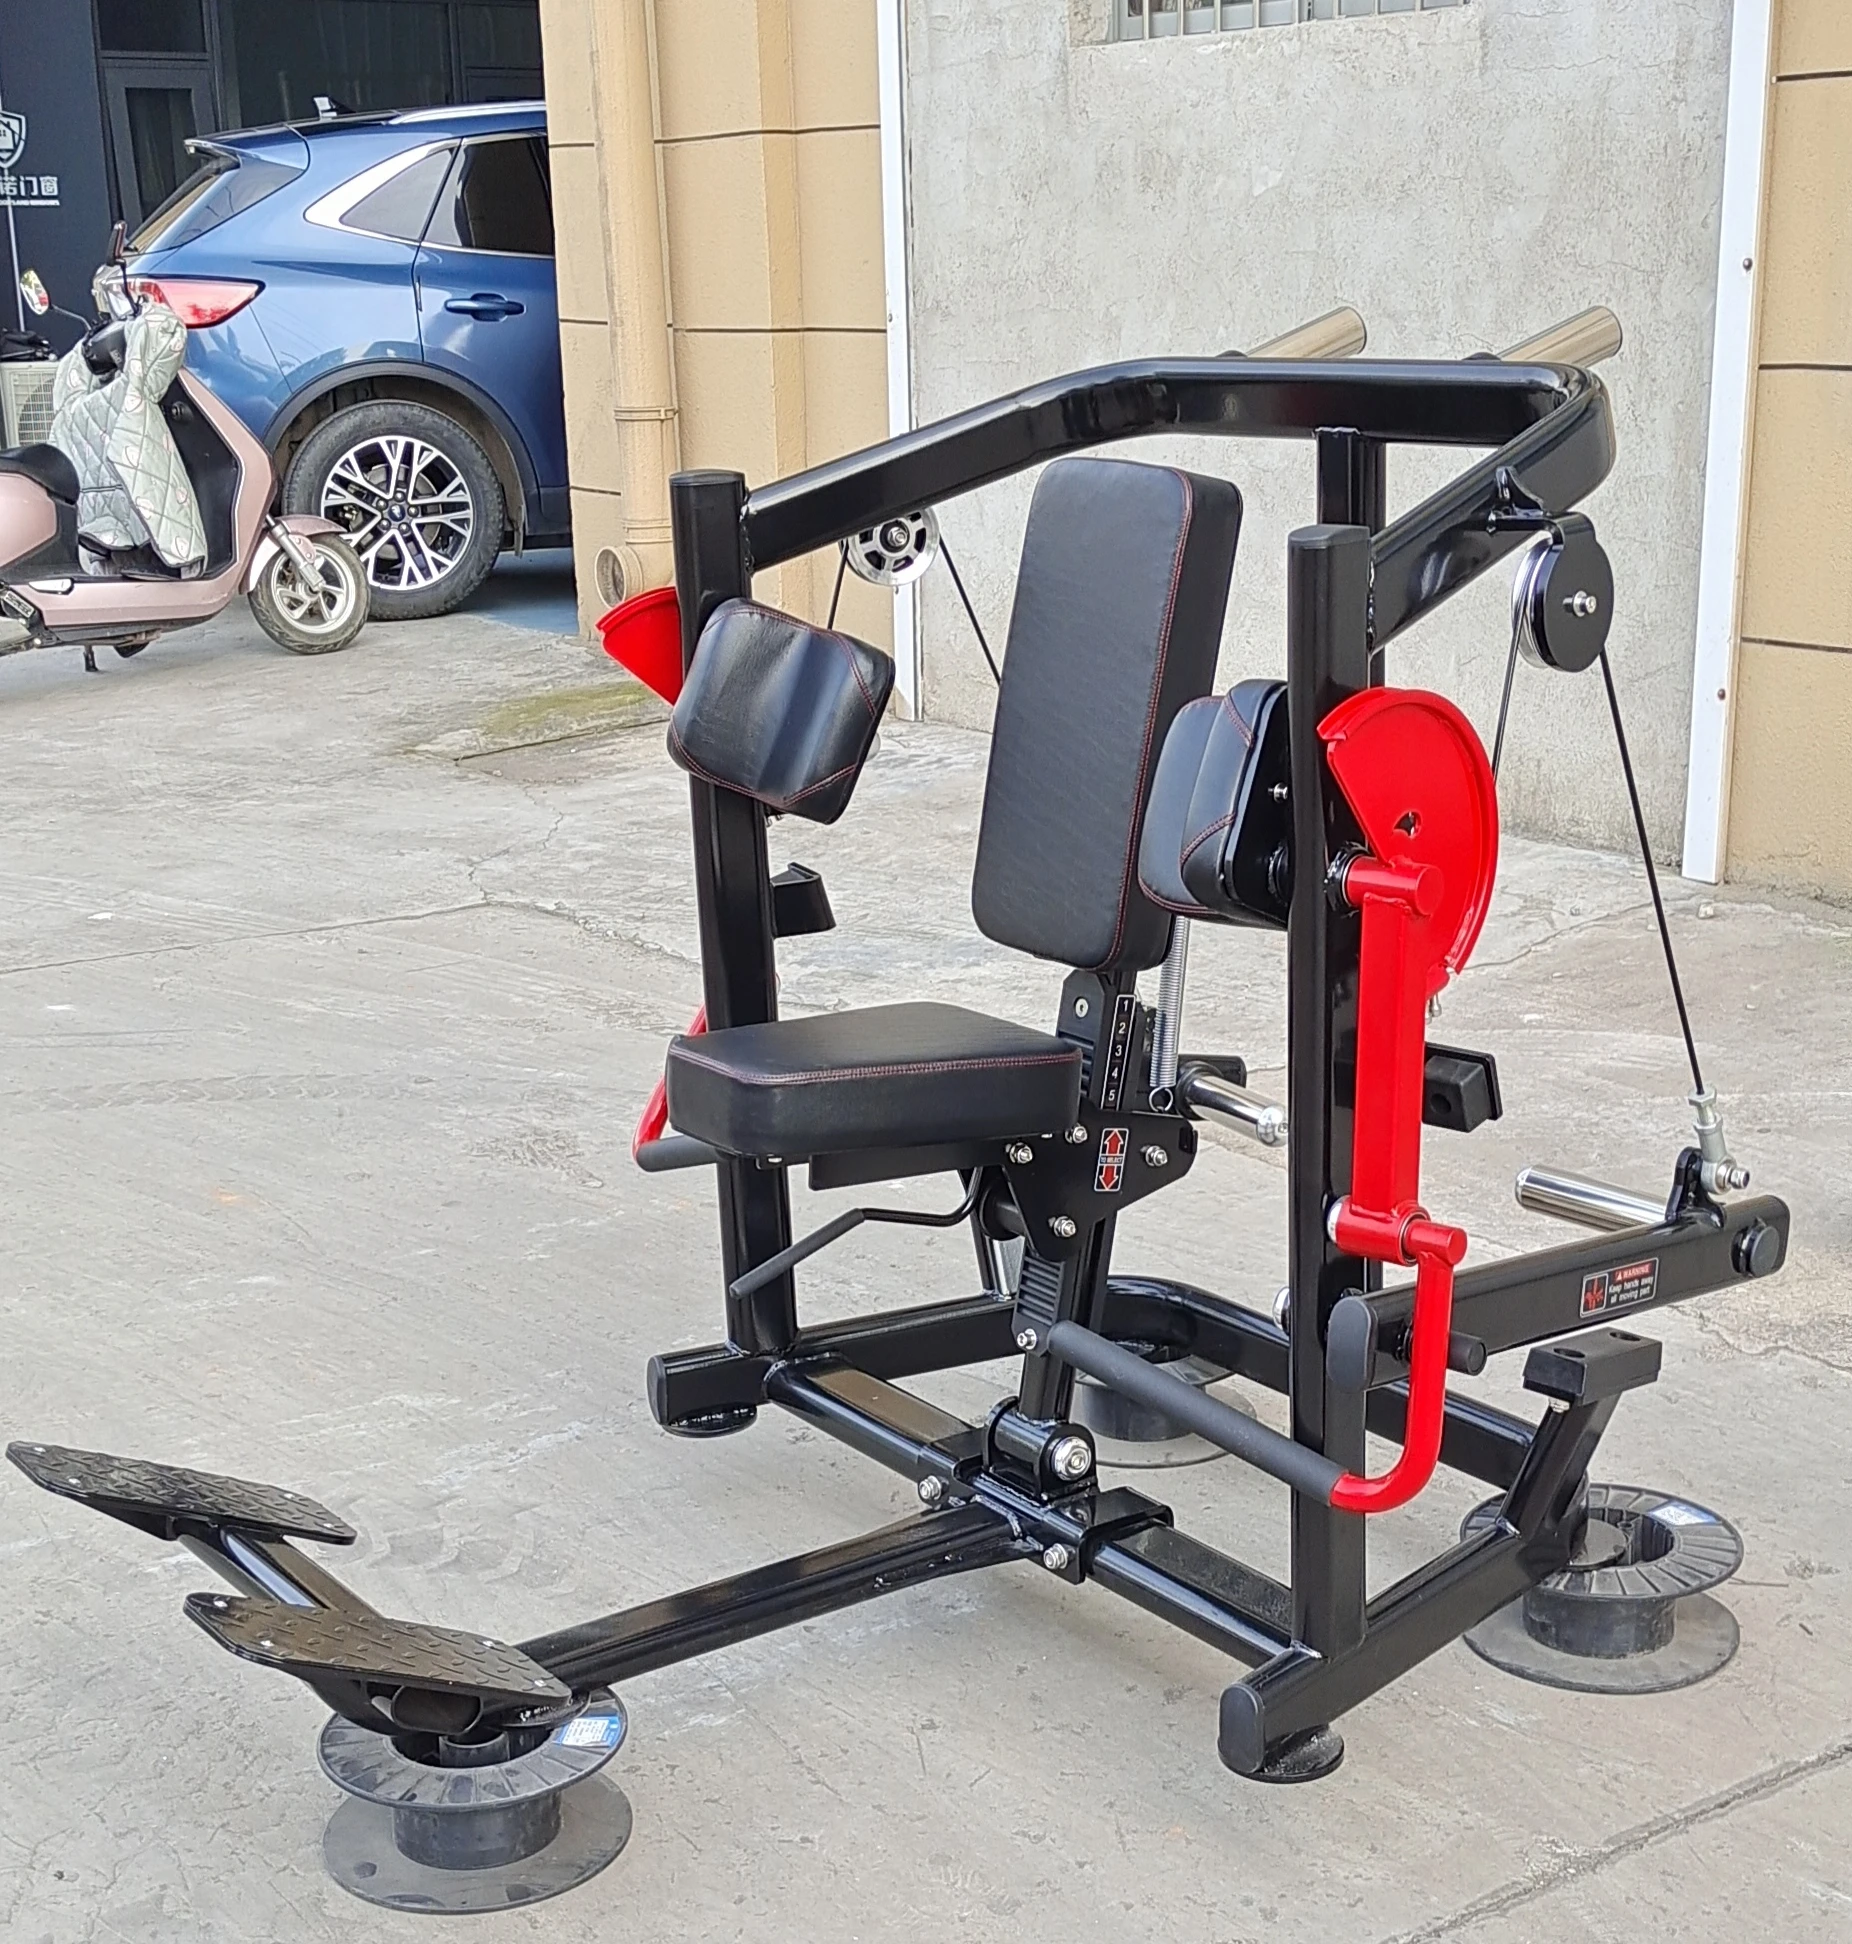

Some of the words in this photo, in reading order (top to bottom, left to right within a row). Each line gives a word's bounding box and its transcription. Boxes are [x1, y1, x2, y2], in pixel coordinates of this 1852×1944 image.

[1123, 999, 1129, 1012] 1
[1118, 1022, 1126, 1034] 2
[1115, 1045, 1122, 1056] 3
[1111, 1067, 1119, 1079] 4
[1108, 1089, 1116, 1101] 5
